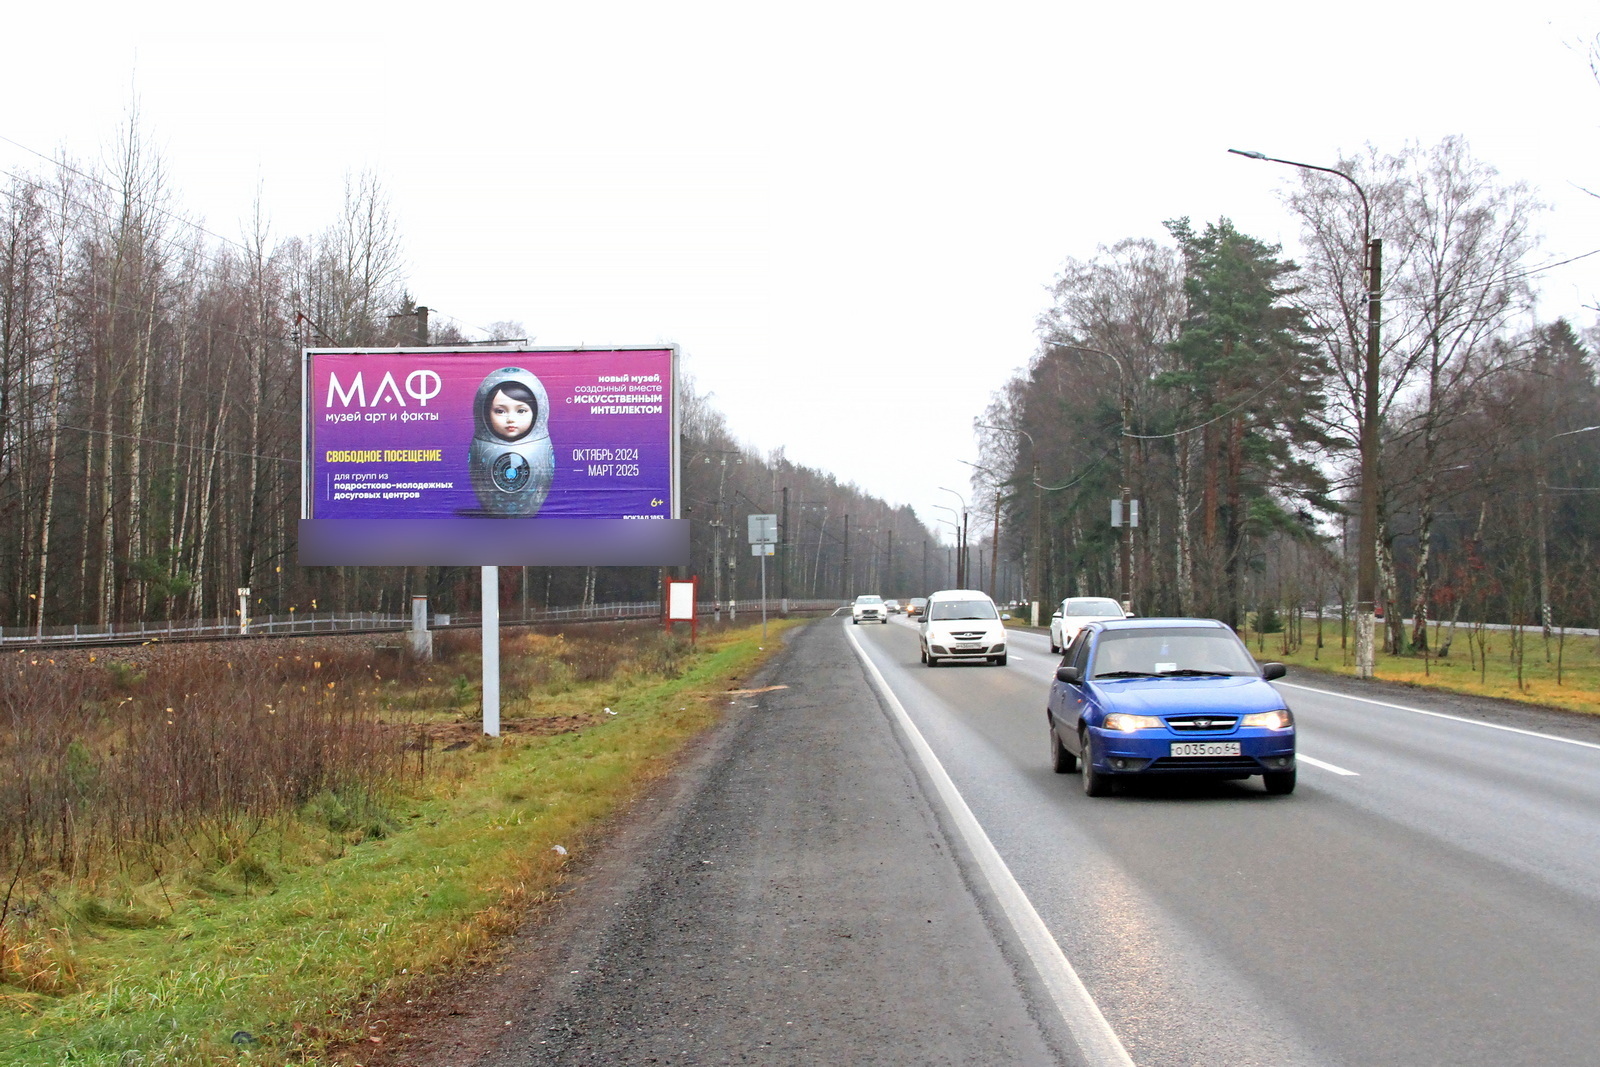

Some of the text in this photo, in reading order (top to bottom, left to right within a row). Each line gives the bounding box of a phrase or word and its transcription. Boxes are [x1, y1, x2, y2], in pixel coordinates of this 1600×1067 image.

[598, 374, 662, 384] новый музей,
[326, 370, 442, 408] МАФ
[574, 384, 662, 393] созданный вместе
[574, 394, 662, 403] ИСКУССТВЕННЫМ
[590, 405, 662, 414] ИНТЕЛЛЕКТОМ
[325, 410, 439, 424] музей арт и факты
[326, 449, 442, 463] СВОБОДНОЕ ПОСЕЩЕНИЕ
[572, 448, 639, 461] ОКТЯБРЬ 2024
[588, 464, 614, 476] МАРТ
[615, 464, 640, 476] 2025
[334, 473, 350, 481] для
[351, 473, 377, 482] групп
[334, 482, 453, 491] подростково-молодежных
[334, 491, 421, 500] досуговых центров
[650, 497, 664, 508] 6+
